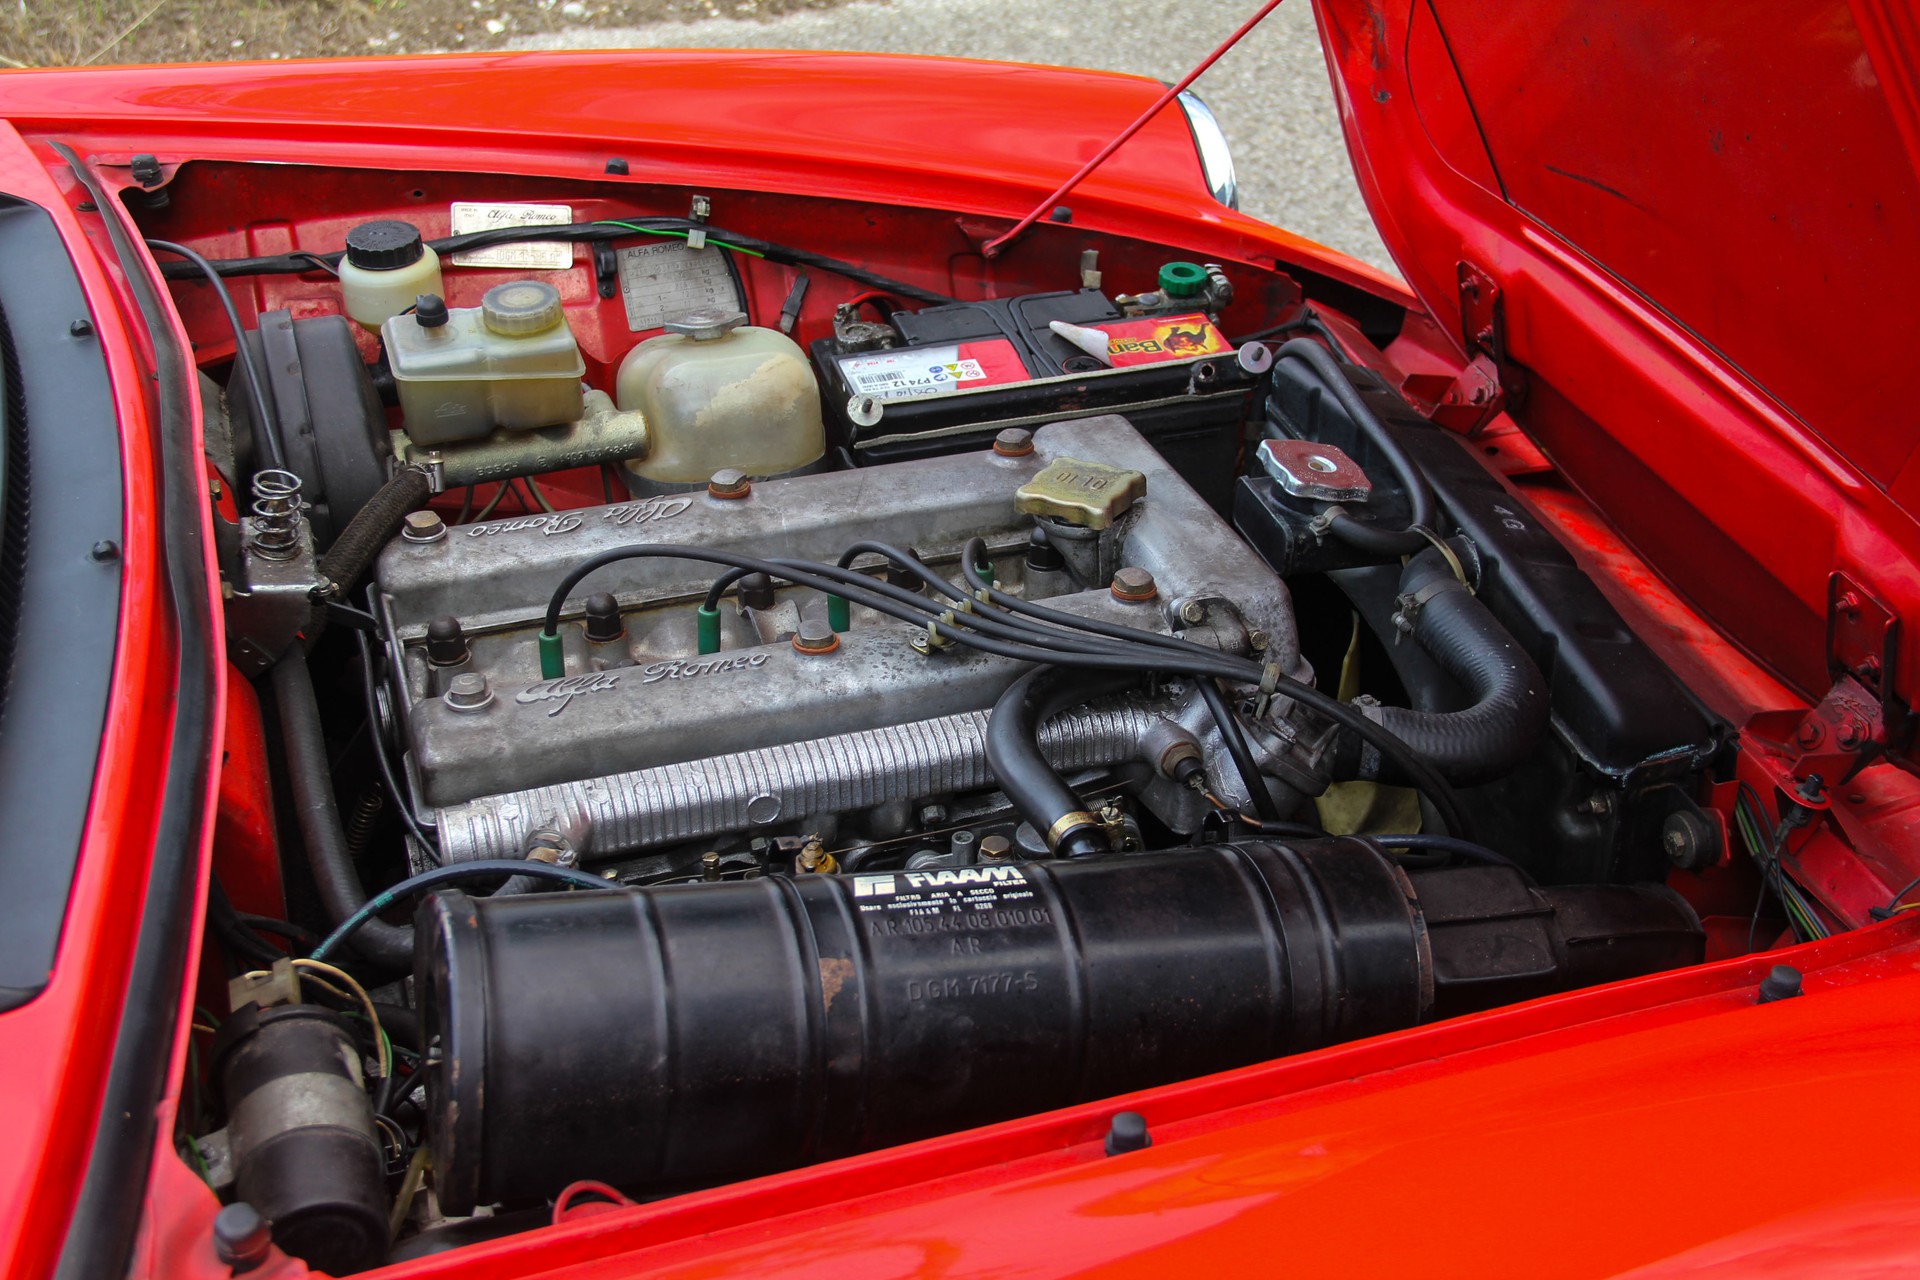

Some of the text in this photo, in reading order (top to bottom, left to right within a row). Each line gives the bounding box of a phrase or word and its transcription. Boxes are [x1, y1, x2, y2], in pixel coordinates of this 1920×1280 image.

[487, 209, 557, 223] Alfa Romeo
[627, 242, 685, 258] ALFA ROMEO
[467, 495, 693, 537] Alfa Romeo
[516, 652, 772, 717] Alfa Romeo
[904, 866, 1024, 888] FIAAM
[993, 879, 1028, 887] FILTER
[859, 904, 882, 912] Usare
[963, 894, 998, 903] cartuccia
[1002, 891, 1034, 900] originale
[895, 894, 921, 902] FILTRO
[931, 891, 950, 899] ARIA
[969, 888, 995, 896] SECCO
[950, 936, 982, 955] AR
[906, 970, 1039, 1002] DGM 7177-S
